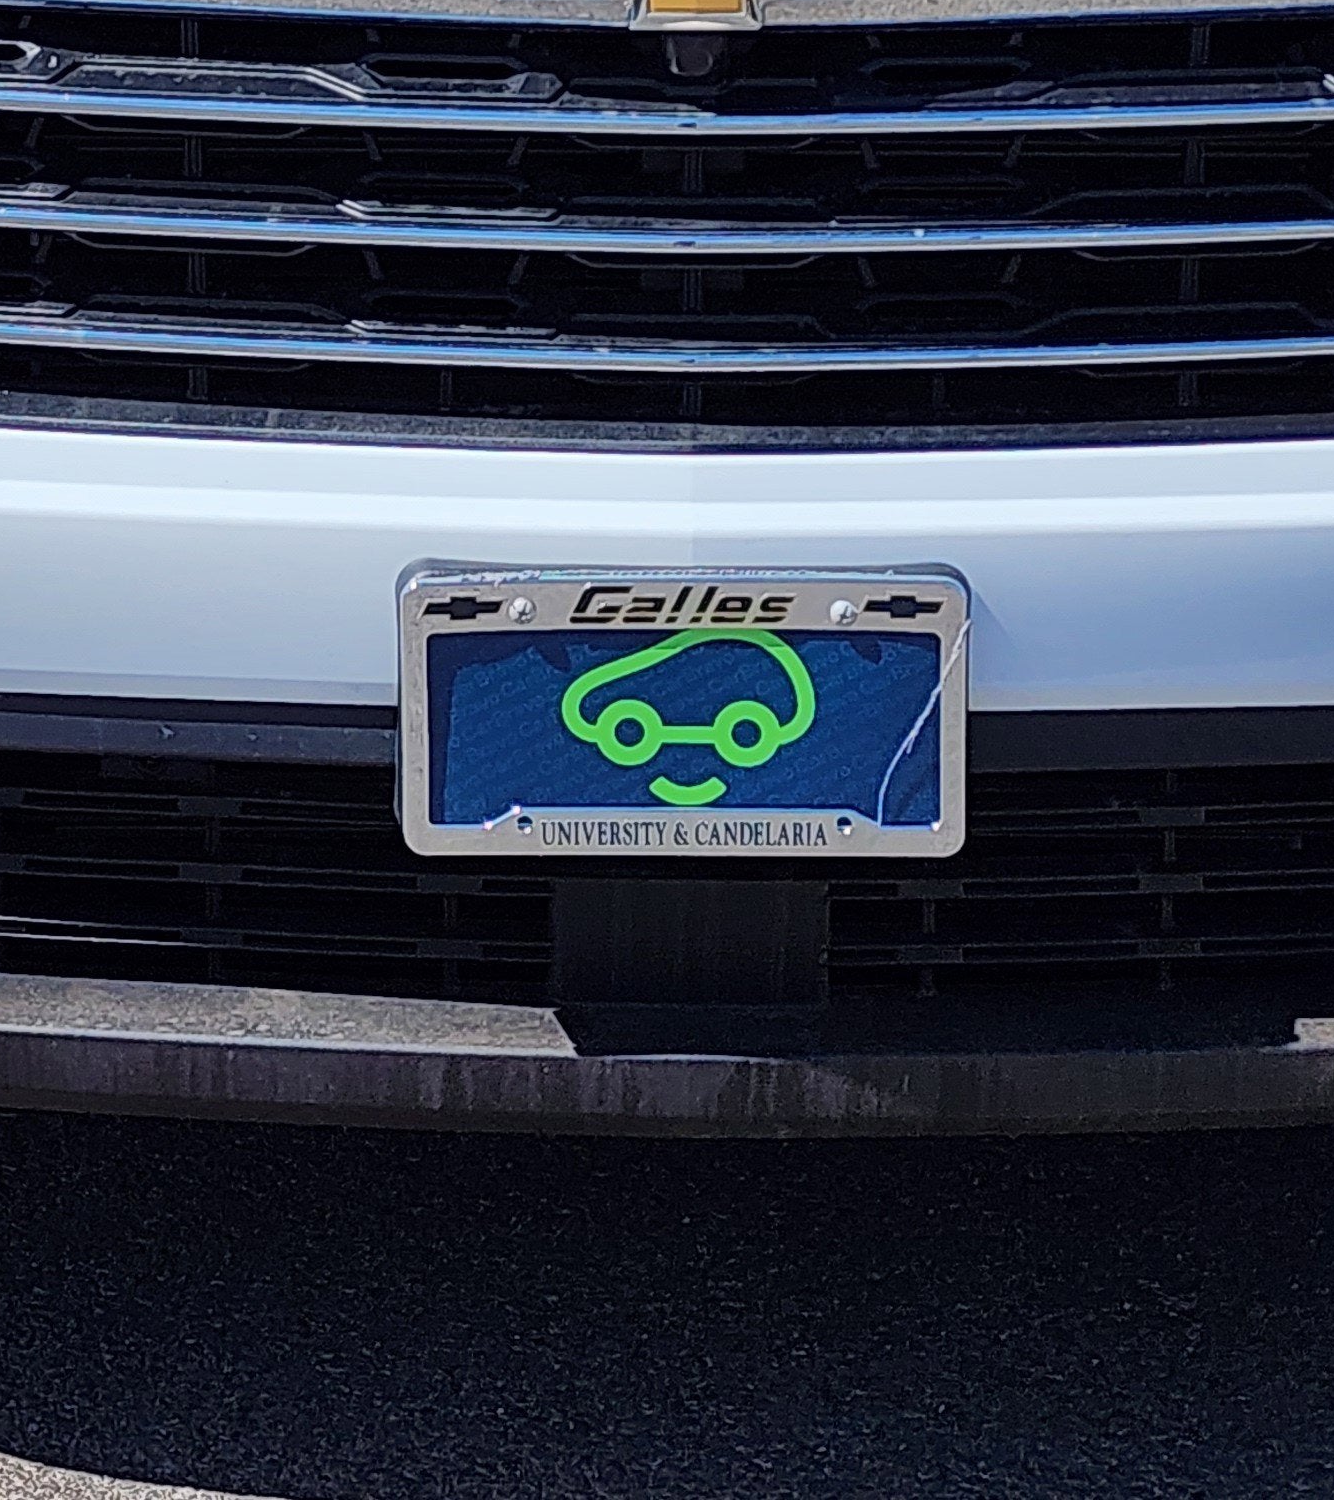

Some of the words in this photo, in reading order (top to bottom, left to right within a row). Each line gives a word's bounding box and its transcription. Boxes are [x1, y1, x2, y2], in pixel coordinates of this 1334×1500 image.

[568, 584, 796, 624] Galles
[540, 819, 667, 848] UNIVERSITY
[672, 819, 690, 848] &
[694, 819, 829, 848] CANDELARIA
